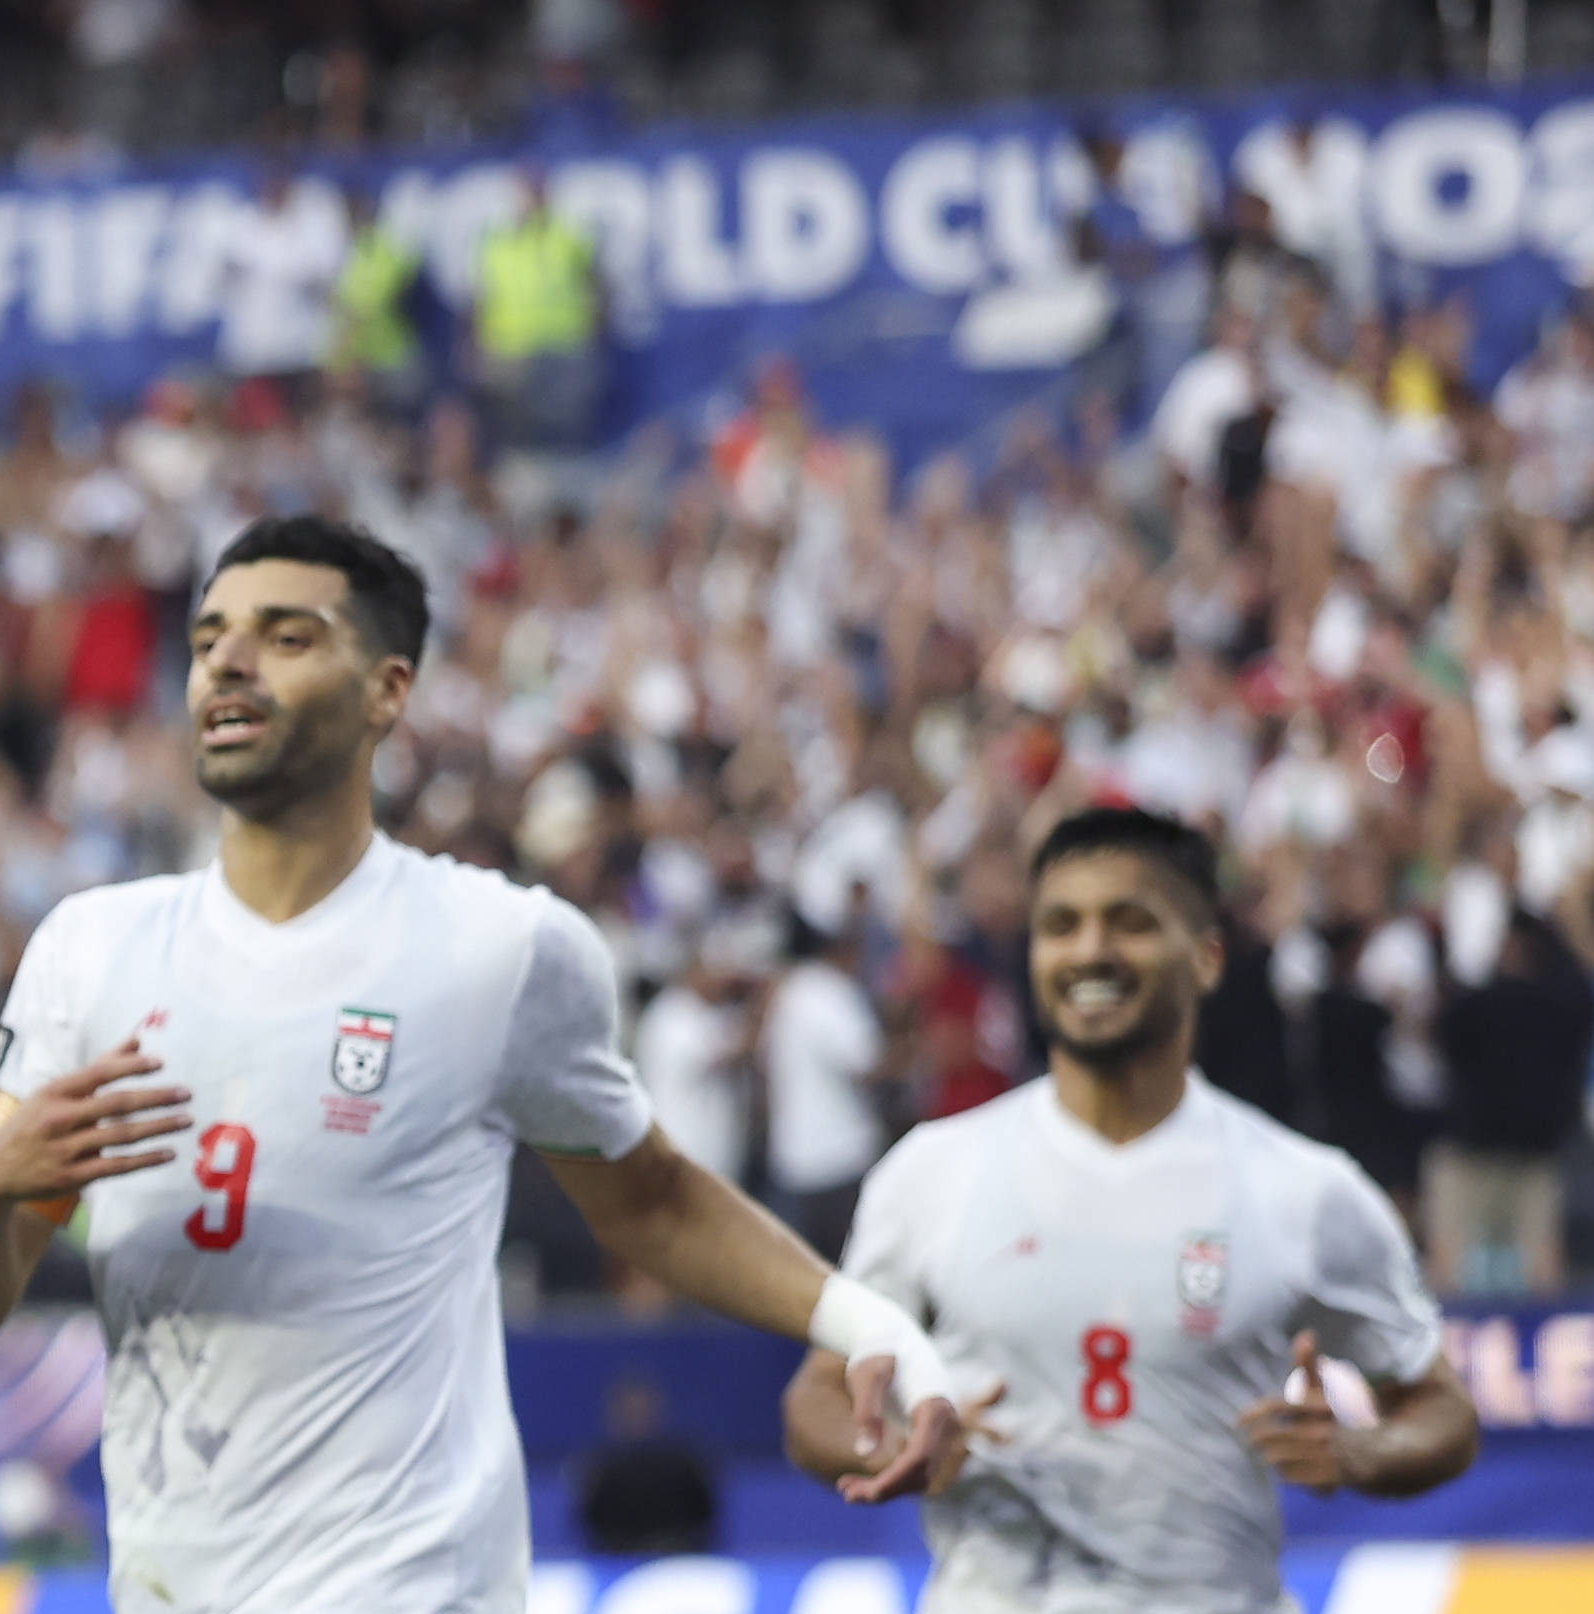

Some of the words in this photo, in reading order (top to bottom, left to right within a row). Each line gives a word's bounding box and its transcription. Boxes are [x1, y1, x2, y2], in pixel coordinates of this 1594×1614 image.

[374, 145, 868, 338] RLD
[184, 1122, 257, 1252] 9
[1080, 1322, 1134, 1426] 8
